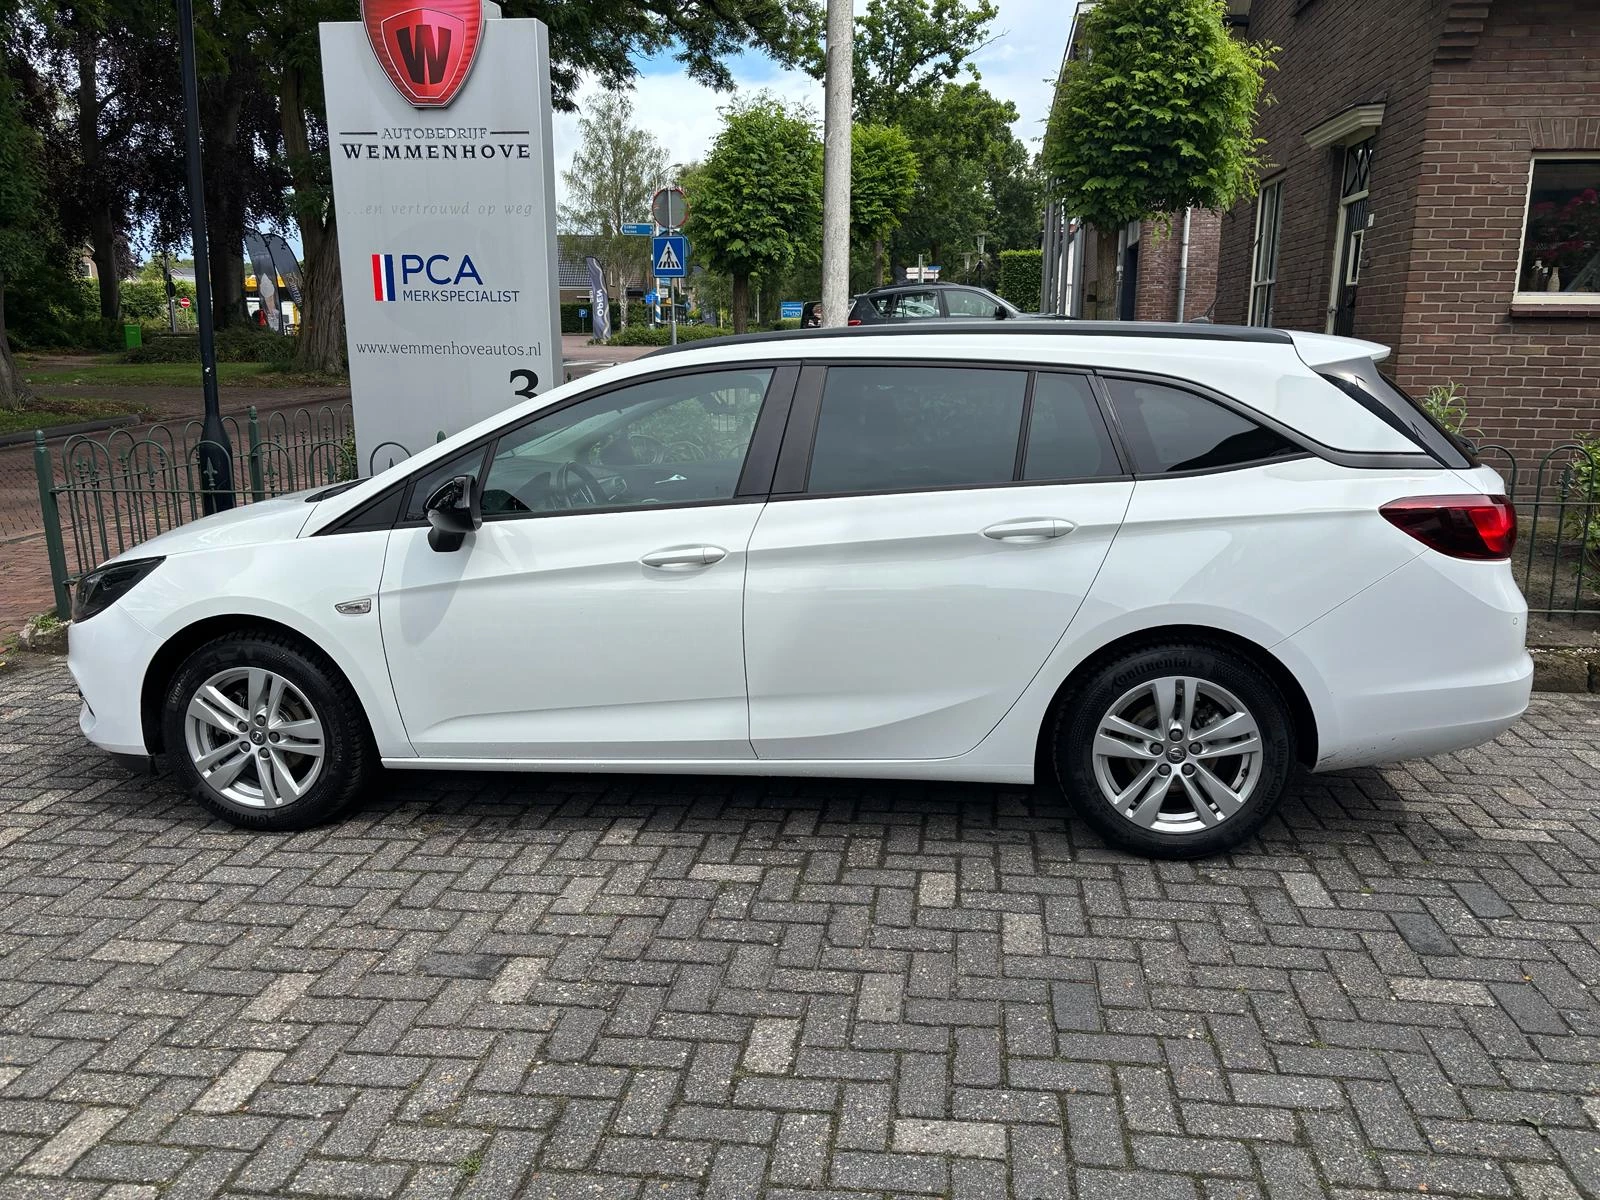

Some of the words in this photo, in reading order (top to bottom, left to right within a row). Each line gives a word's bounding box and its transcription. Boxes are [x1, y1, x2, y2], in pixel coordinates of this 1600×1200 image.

[396, 24, 452, 85] W
[381, 128, 488, 140] AUTOBEDRIJF
[340, 144, 531, 160] WEMMENHOVE
[391, 202, 470, 216] vertrouwd
[478, 204, 496, 217] op
[504, 203, 533, 217] weg
[401, 254, 484, 286] PCA
[403, 290, 520, 303] MERKSPECIALIST
[596, 288, 604, 317] OPEN
[356, 341, 542, 357] www.wemmenhoveautos.nl
[509, 368, 540, 400] 3
